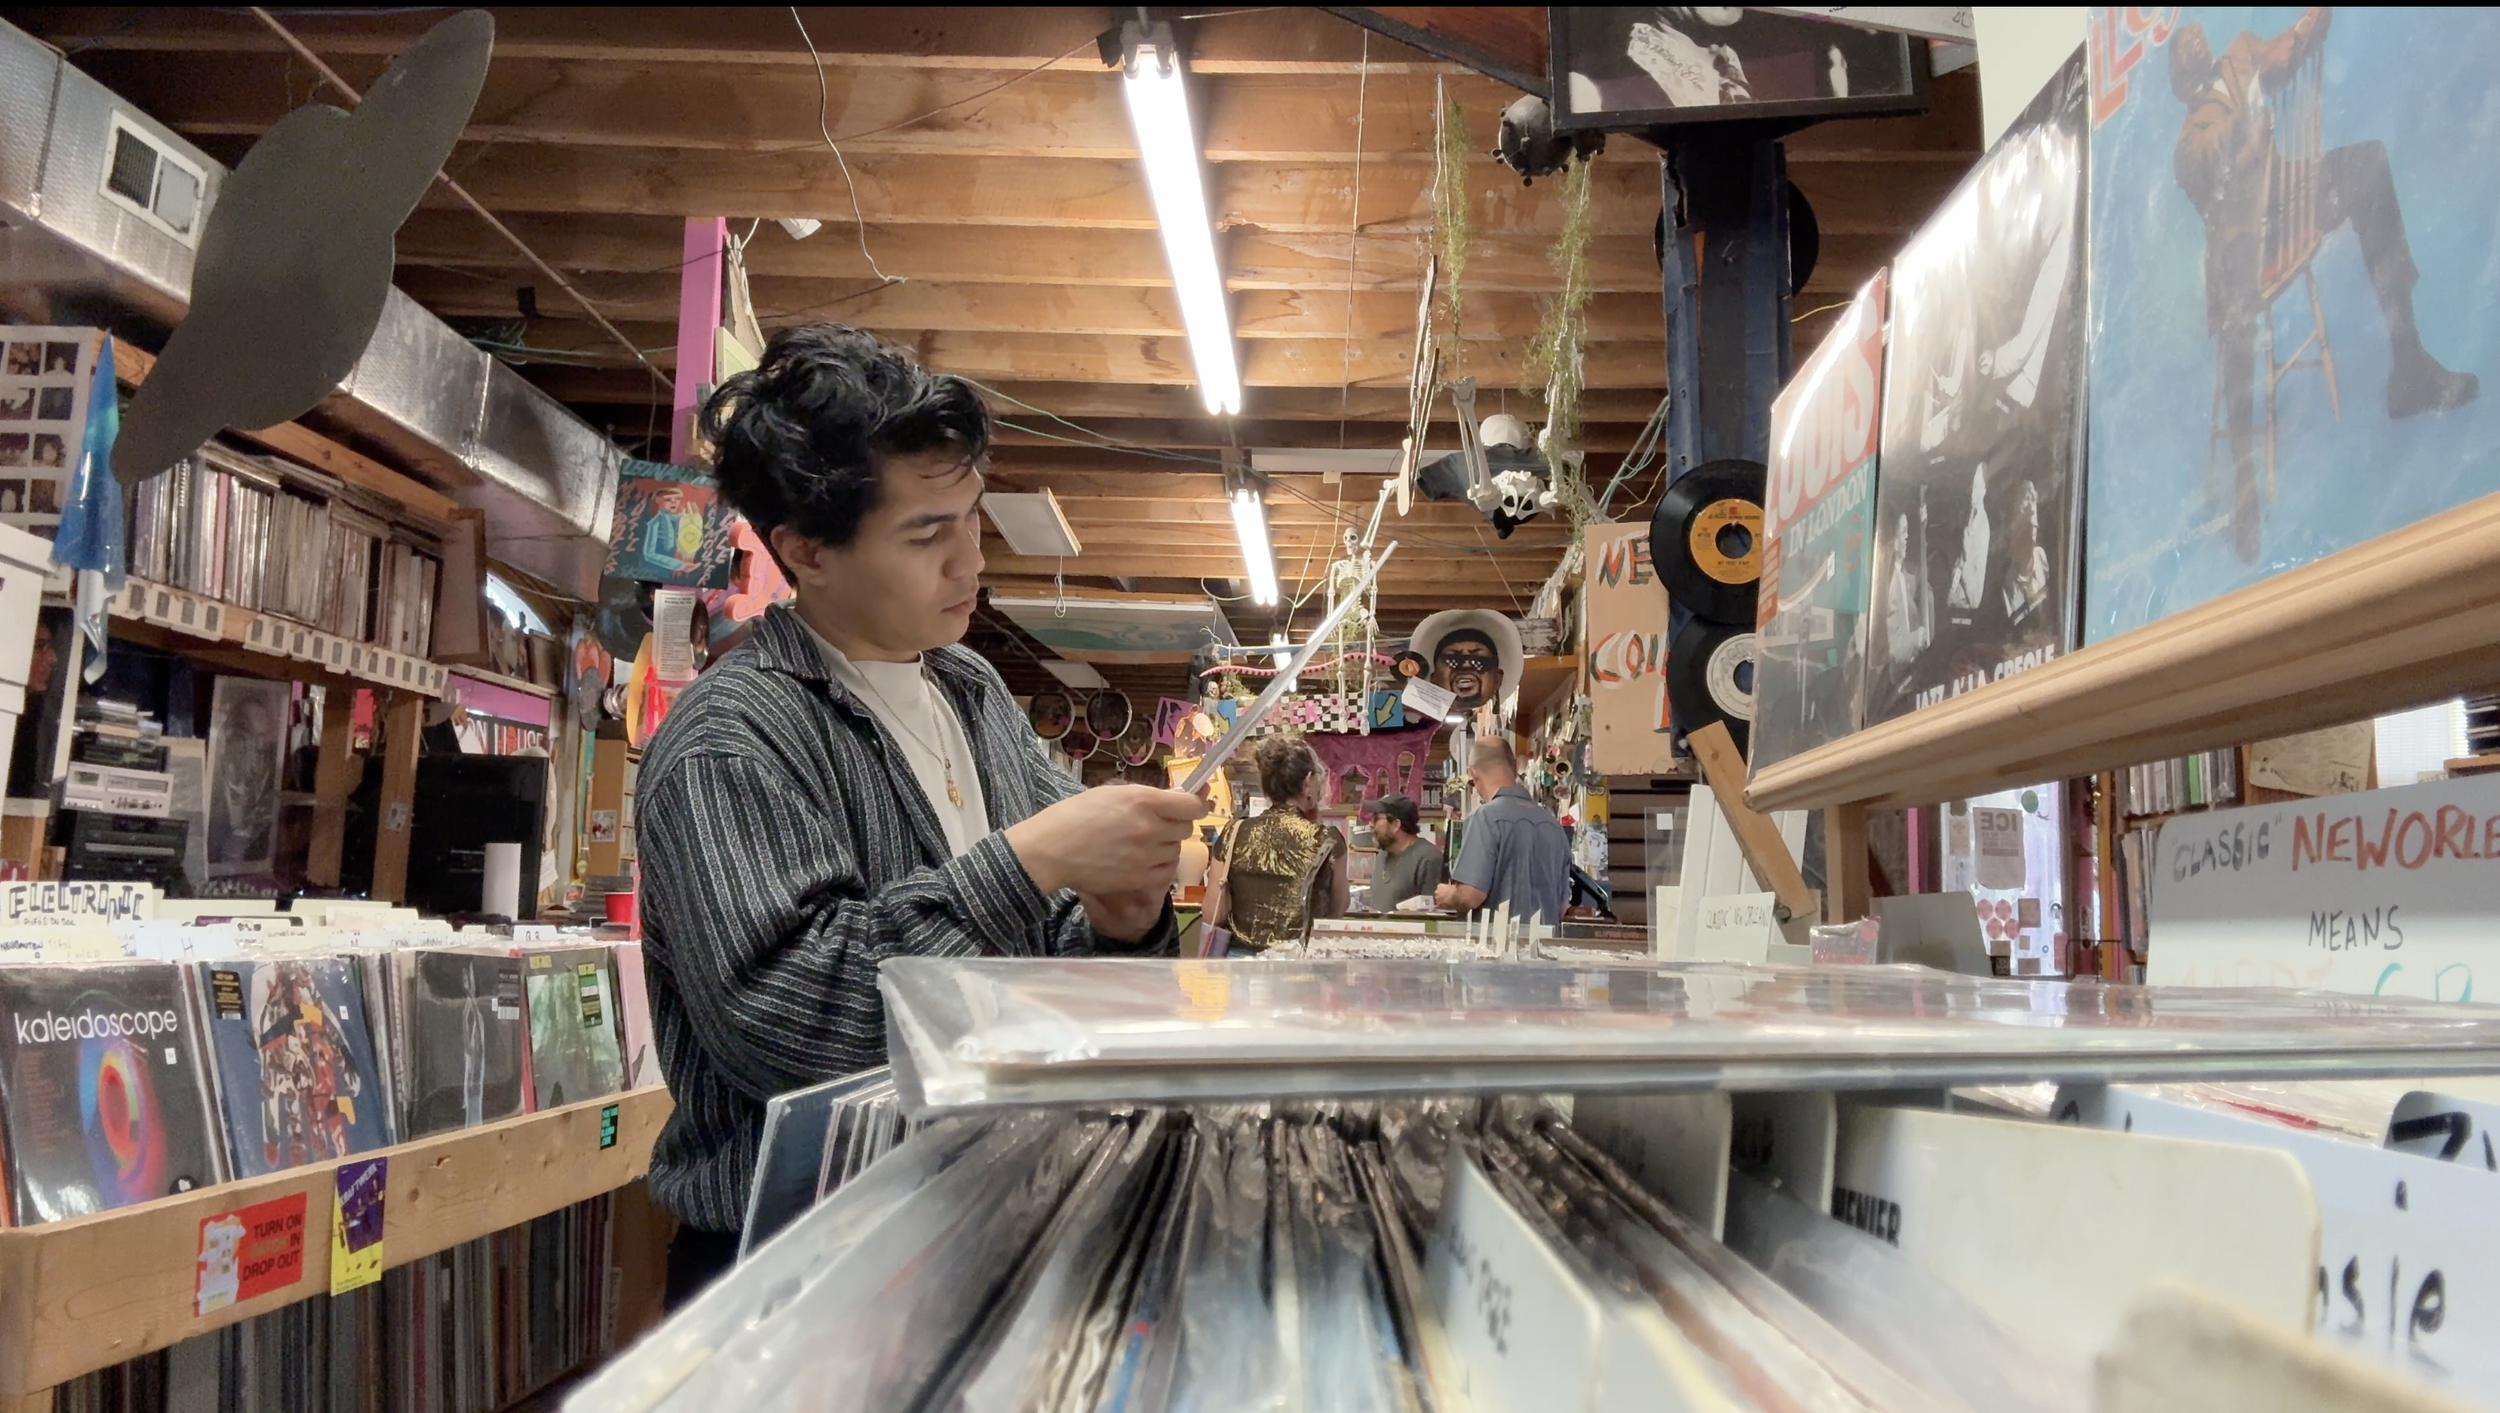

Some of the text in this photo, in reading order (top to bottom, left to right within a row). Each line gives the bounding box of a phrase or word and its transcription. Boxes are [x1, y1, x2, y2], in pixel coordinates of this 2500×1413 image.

[1788, 463, 1870, 559] IN LONDON
[9, 882, 145, 925] ELECTRONIC
[2308, 904, 2404, 952] MEANS
[14, 1008, 178, 1045] kaleidoscope
[340, 1162, 379, 1207] KRAFTWERK
[253, 1212, 302, 1240] TURN ON
[290, 1232, 301, 1247] IN
[243, 1249, 300, 1282] DROP OUT
